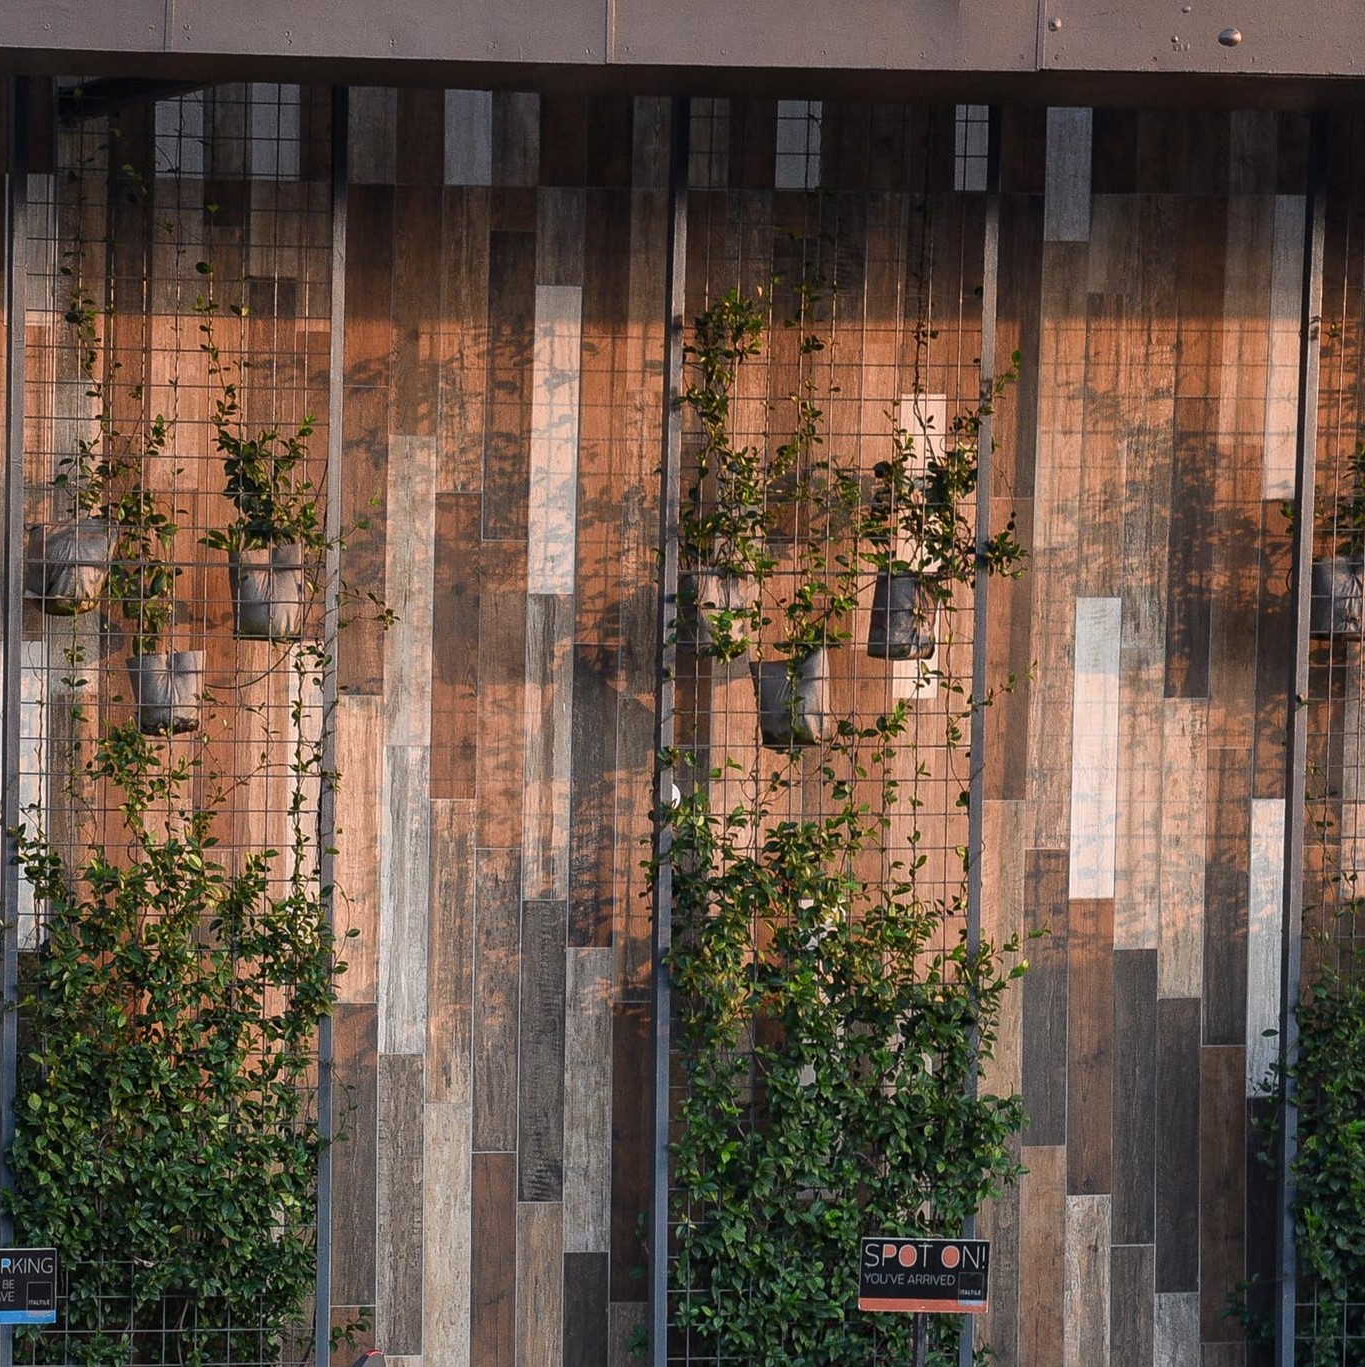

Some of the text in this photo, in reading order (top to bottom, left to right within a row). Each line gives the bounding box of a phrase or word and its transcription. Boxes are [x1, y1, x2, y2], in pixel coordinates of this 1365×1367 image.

[864, 1243, 986, 1269] SPOT ON!
[2, 1279, 15, 1290] BE
[864, 1273, 956, 1286] YOU'VE ARRIVED
